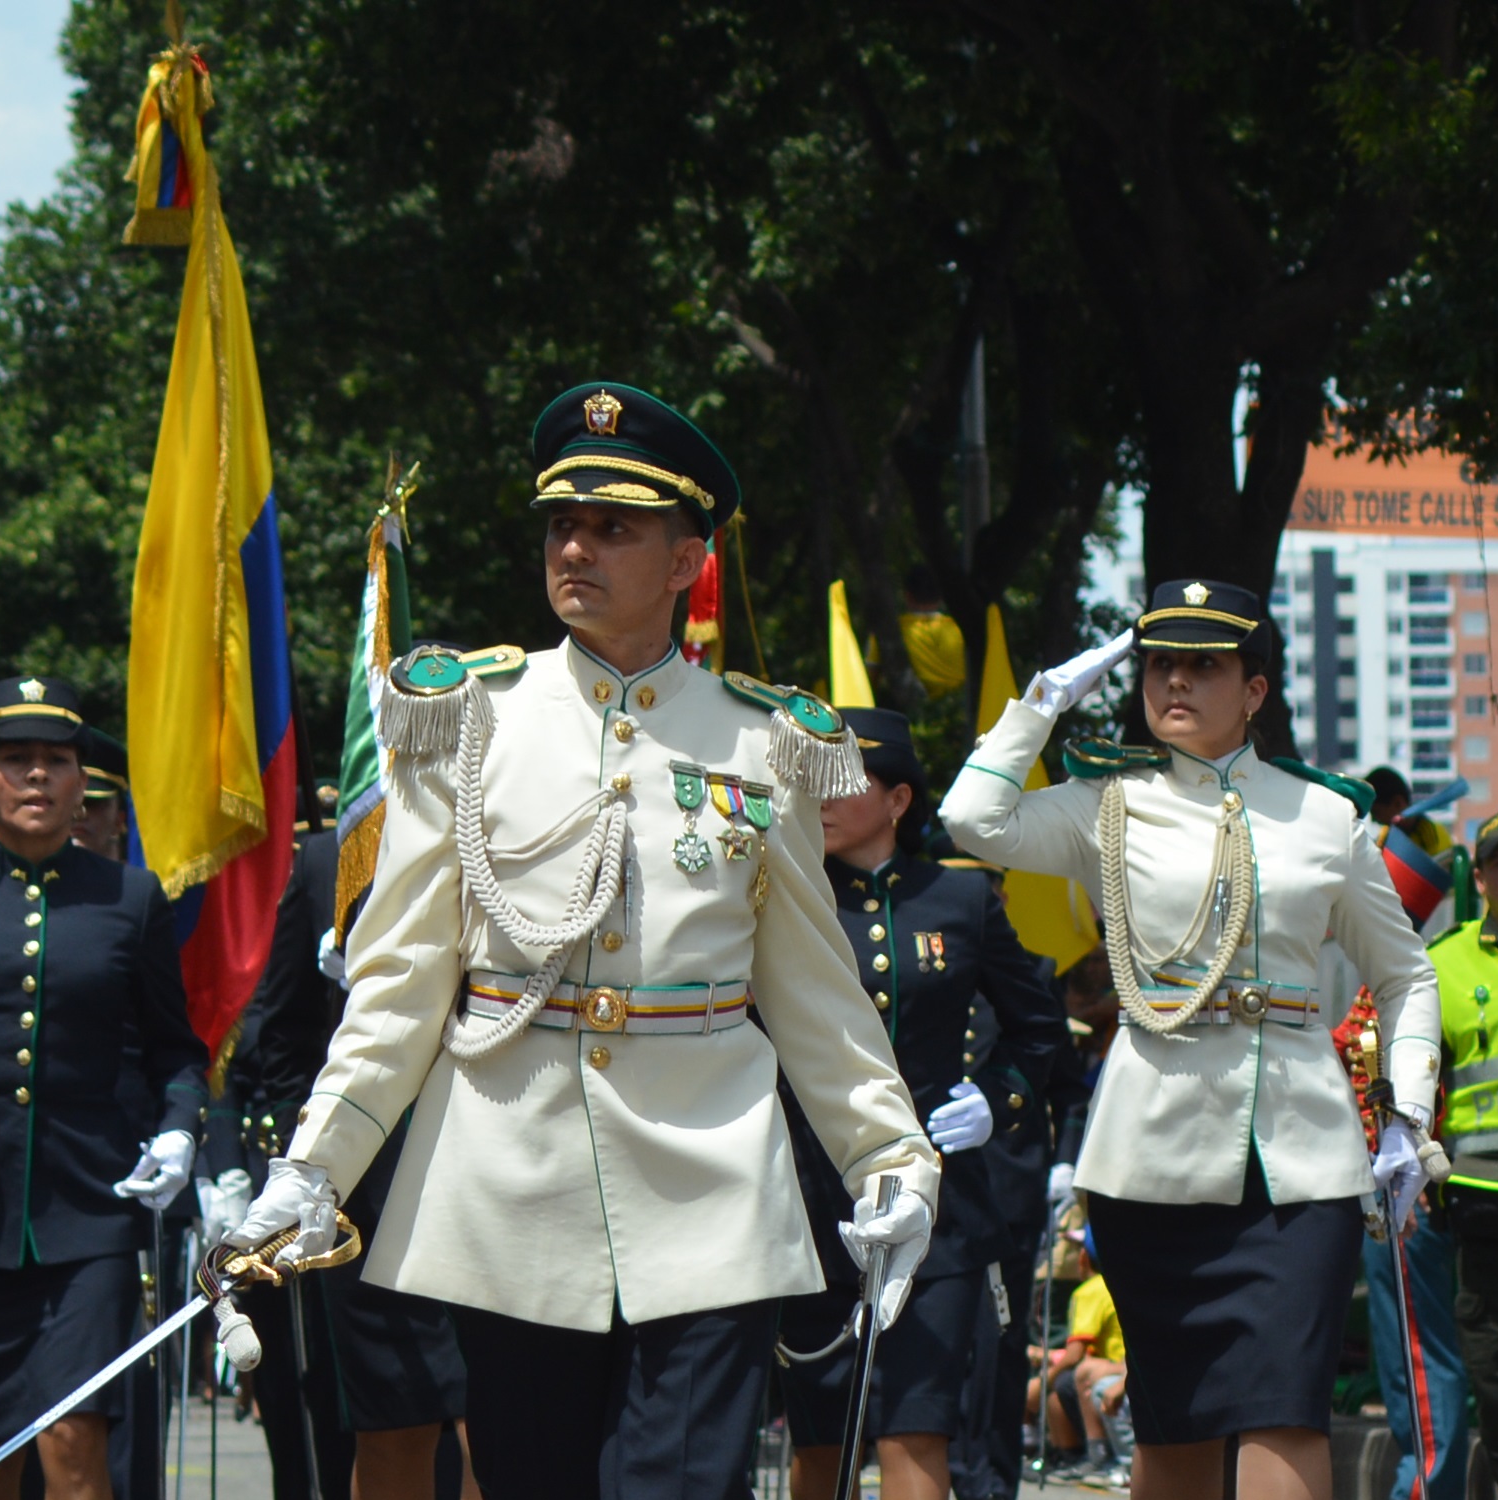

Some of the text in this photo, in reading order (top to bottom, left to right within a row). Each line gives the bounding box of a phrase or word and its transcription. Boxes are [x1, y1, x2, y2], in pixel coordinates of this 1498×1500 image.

[1303, 488, 1346, 523] SUR
[1354, 490, 1410, 524] TOME
[1419, 492, 1484, 527] CALLE
